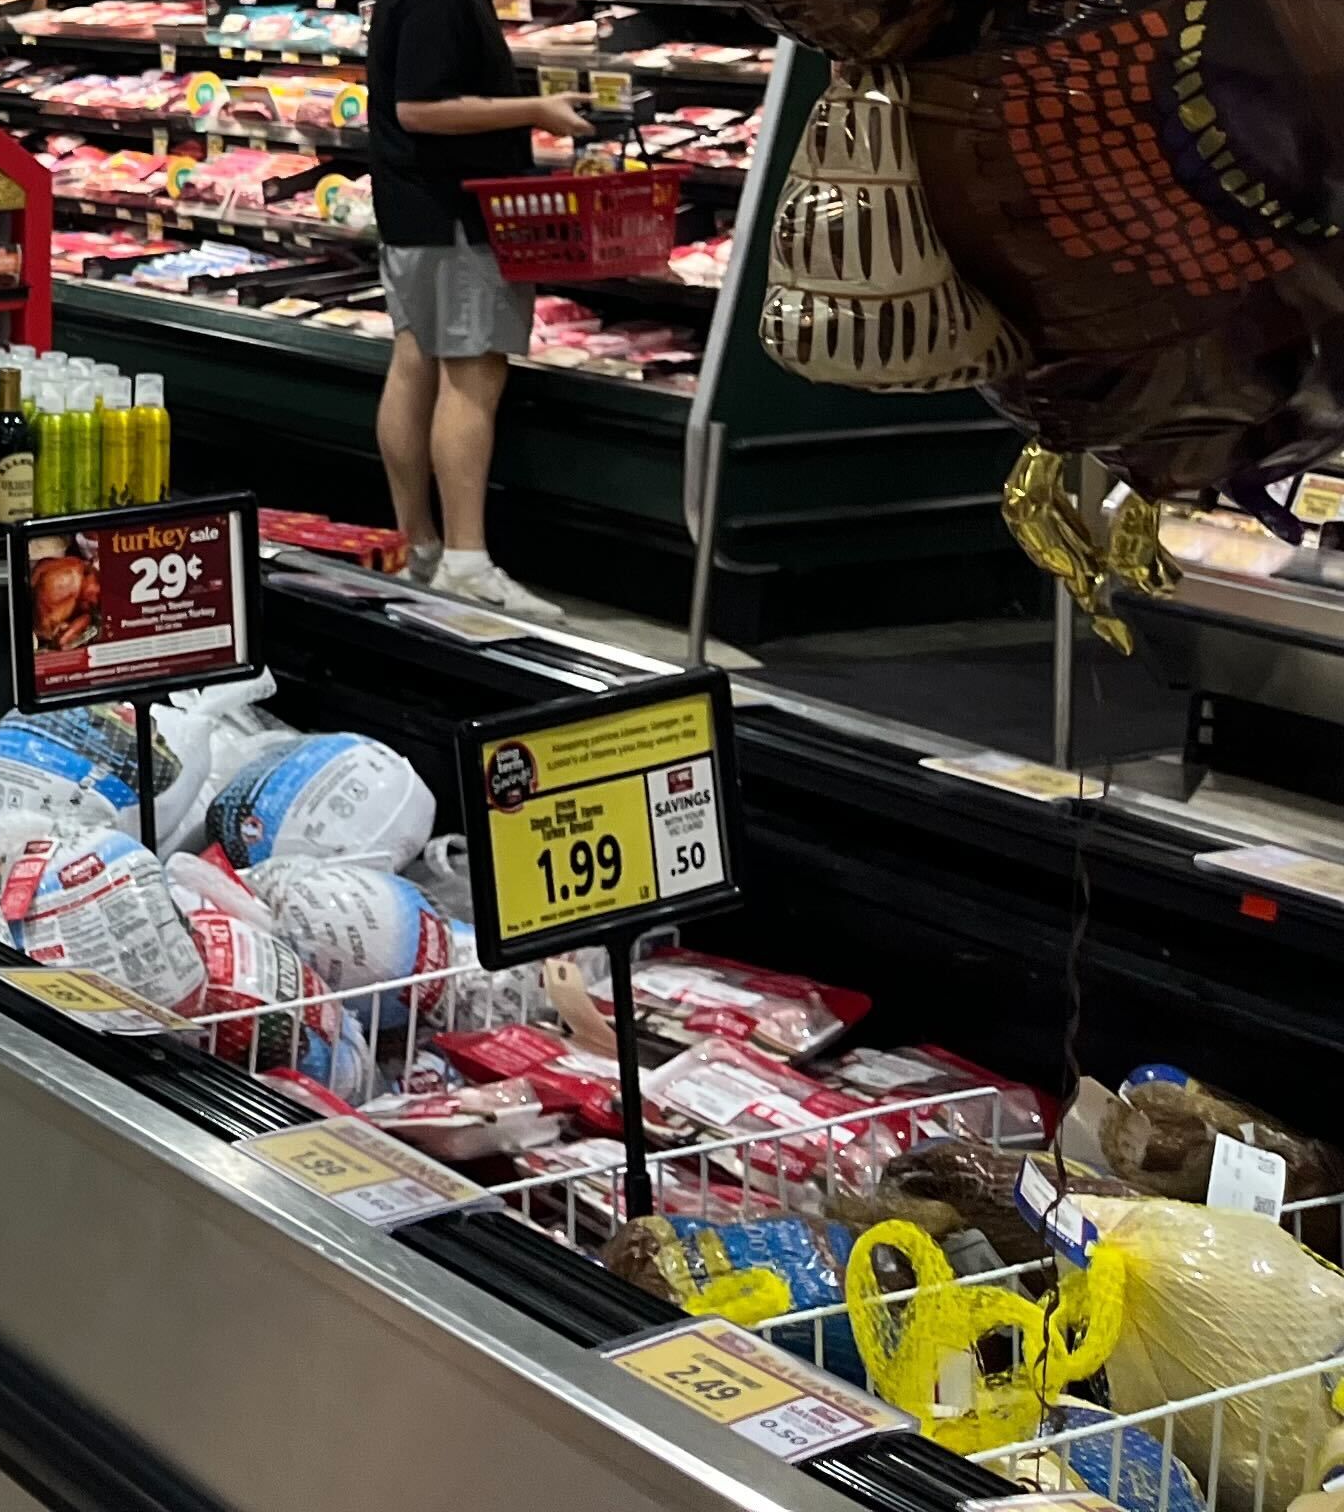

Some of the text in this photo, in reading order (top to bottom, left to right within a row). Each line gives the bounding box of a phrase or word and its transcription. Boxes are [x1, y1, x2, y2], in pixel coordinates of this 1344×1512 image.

[111, 526, 220, 555] turkey sale
[654, 789, 712, 818] SAVINGS
[537, 834, 623, 905] 1.99
[669, 841, 706, 878] .50
[663, 1364, 743, 1402] 2.49
